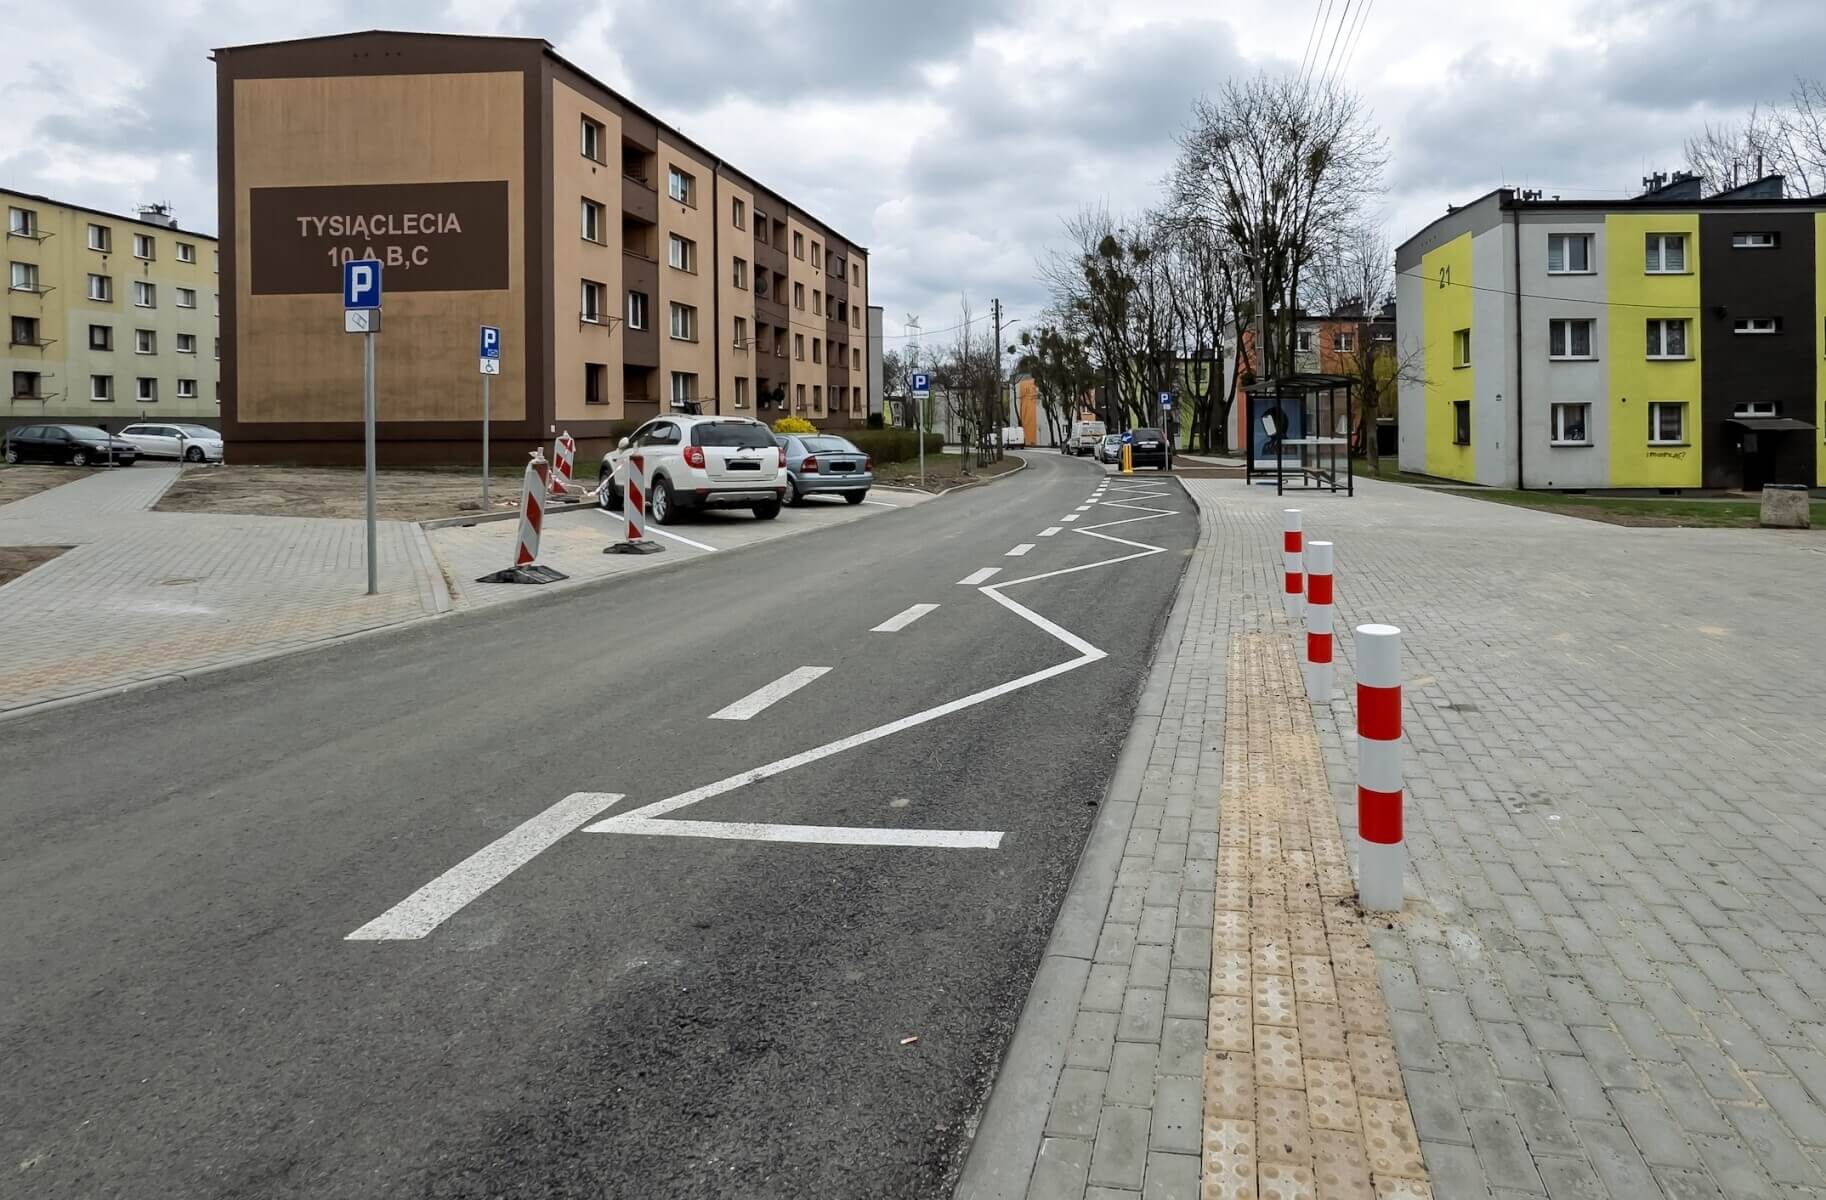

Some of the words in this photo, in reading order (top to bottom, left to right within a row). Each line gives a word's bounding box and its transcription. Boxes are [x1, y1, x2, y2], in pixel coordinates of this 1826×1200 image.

[297, 212, 462, 240] TYSIĄCLECIA
[327, 246, 354, 267] 10
[351, 265, 373, 303] P
[1439, 263, 1451, 289] 21
[484, 329, 497, 348] P
[915, 375, 926, 389] P
[1160, 393, 1169, 403] P
